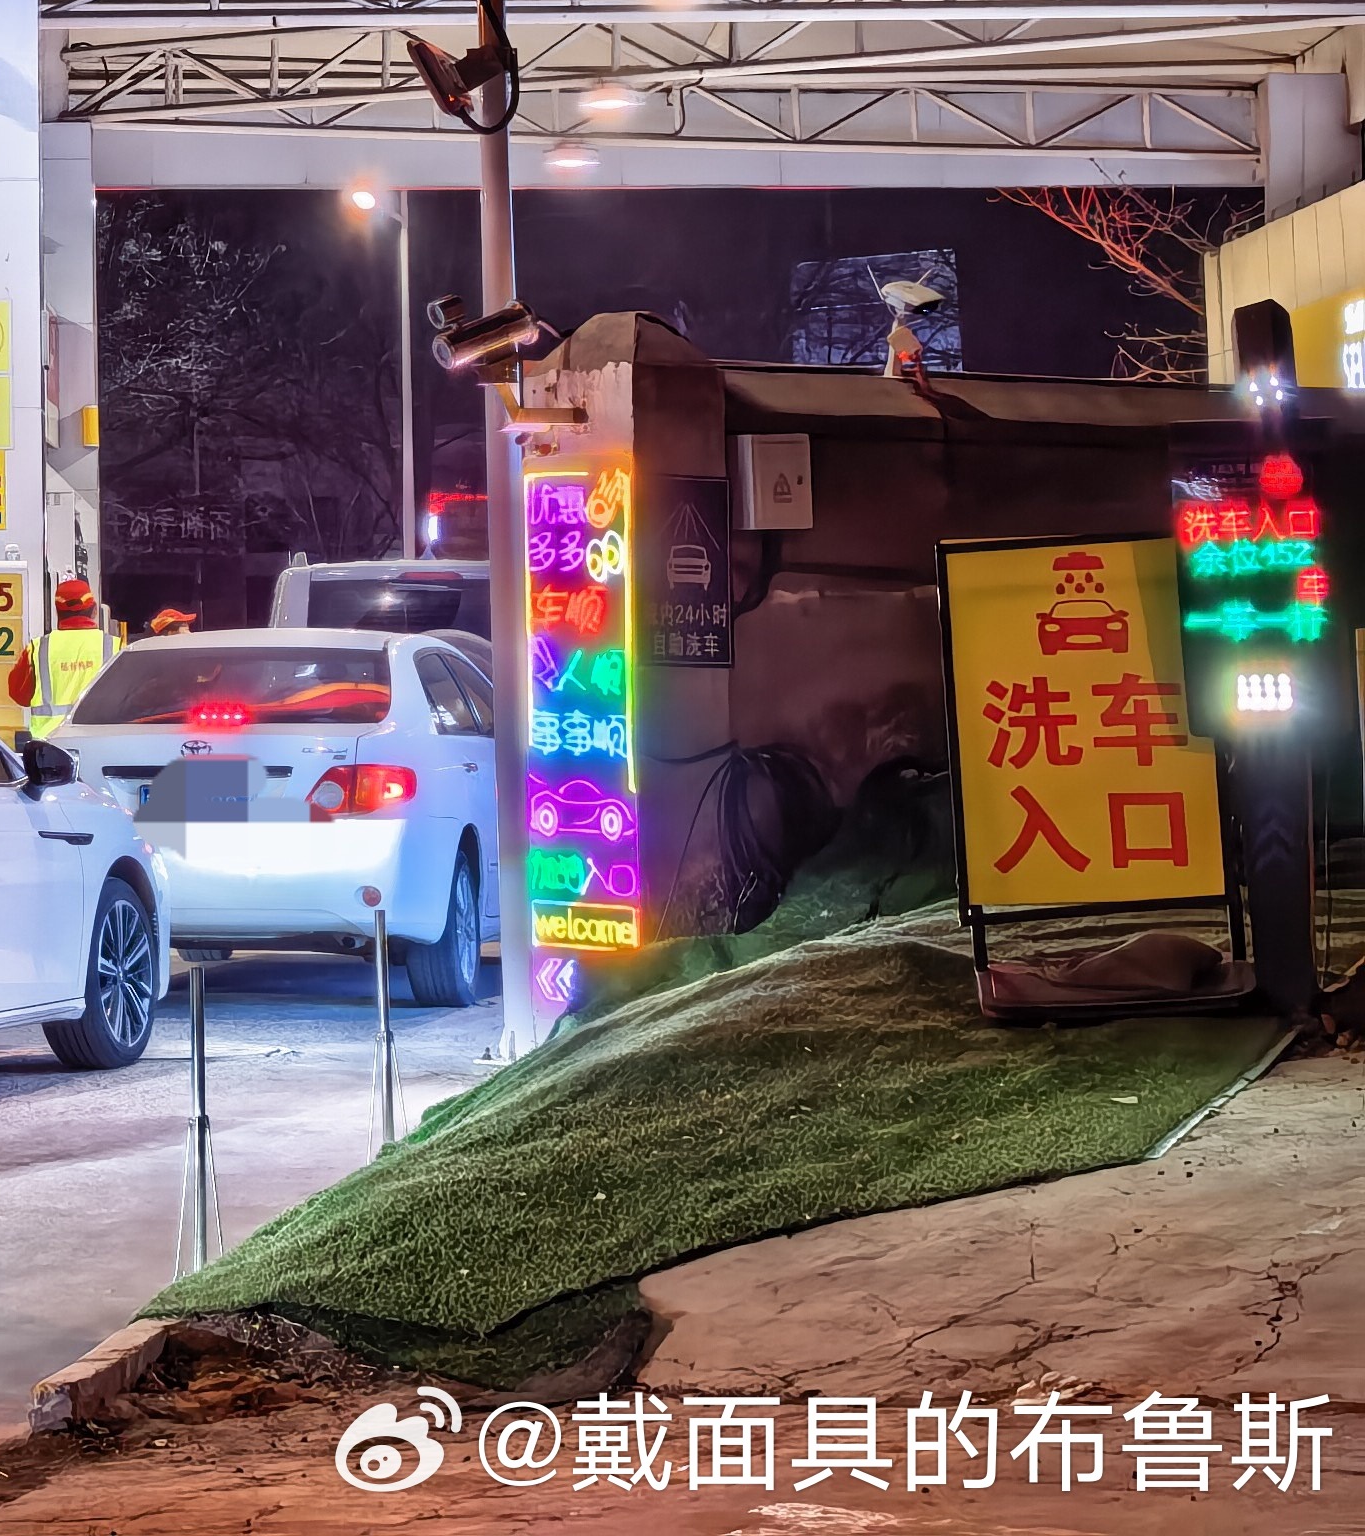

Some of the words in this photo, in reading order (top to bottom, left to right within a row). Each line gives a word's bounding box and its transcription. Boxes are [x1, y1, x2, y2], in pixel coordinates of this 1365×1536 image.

[1183, 506, 1317, 542] 洗车入口
[529, 530, 586, 572] 多多
[982, 673, 1189, 770] 洗车
[993, 785, 1189, 874] 入口
[533, 907, 636, 946] welcome
